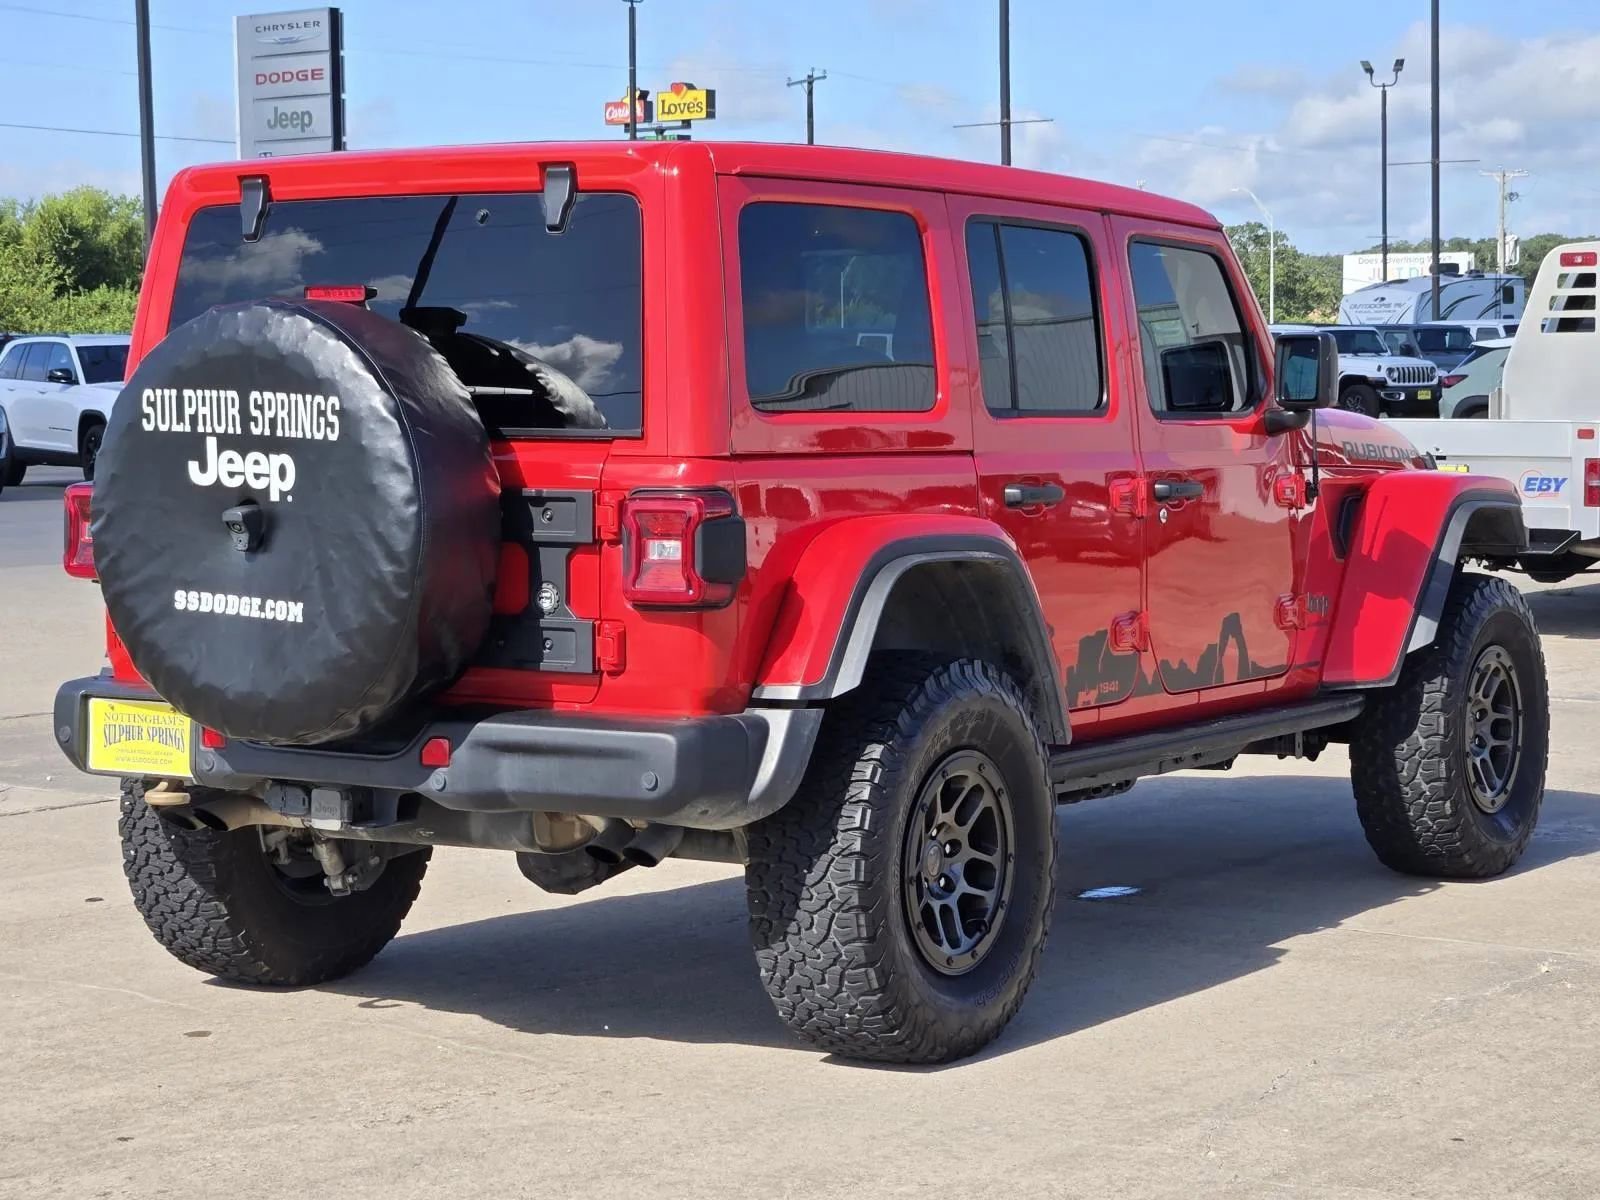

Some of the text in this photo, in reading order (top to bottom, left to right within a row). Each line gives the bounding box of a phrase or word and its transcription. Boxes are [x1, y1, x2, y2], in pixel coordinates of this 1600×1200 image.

[255, 20, 321, 33] CHRYSLER
[255, 68, 324, 85] DODGE
[660, 98, 704, 115] Love's
[267, 106, 313, 133] Jeep
[1380, 256, 1425, 267] dvertising
[141, 388, 340, 441] SULPHUR SPRINGS
[1342, 441, 1411, 463] RUBICON
[187, 436, 296, 502] Jeep
[1523, 476, 1569, 492] EBY
[174, 589, 304, 623] SSDODGE.COM
[1099, 680, 1120, 694] 1941
[103, 711, 185, 727] NOTTINGHAM'S
[103, 723, 185, 753] SULPHUR SPRINGS
